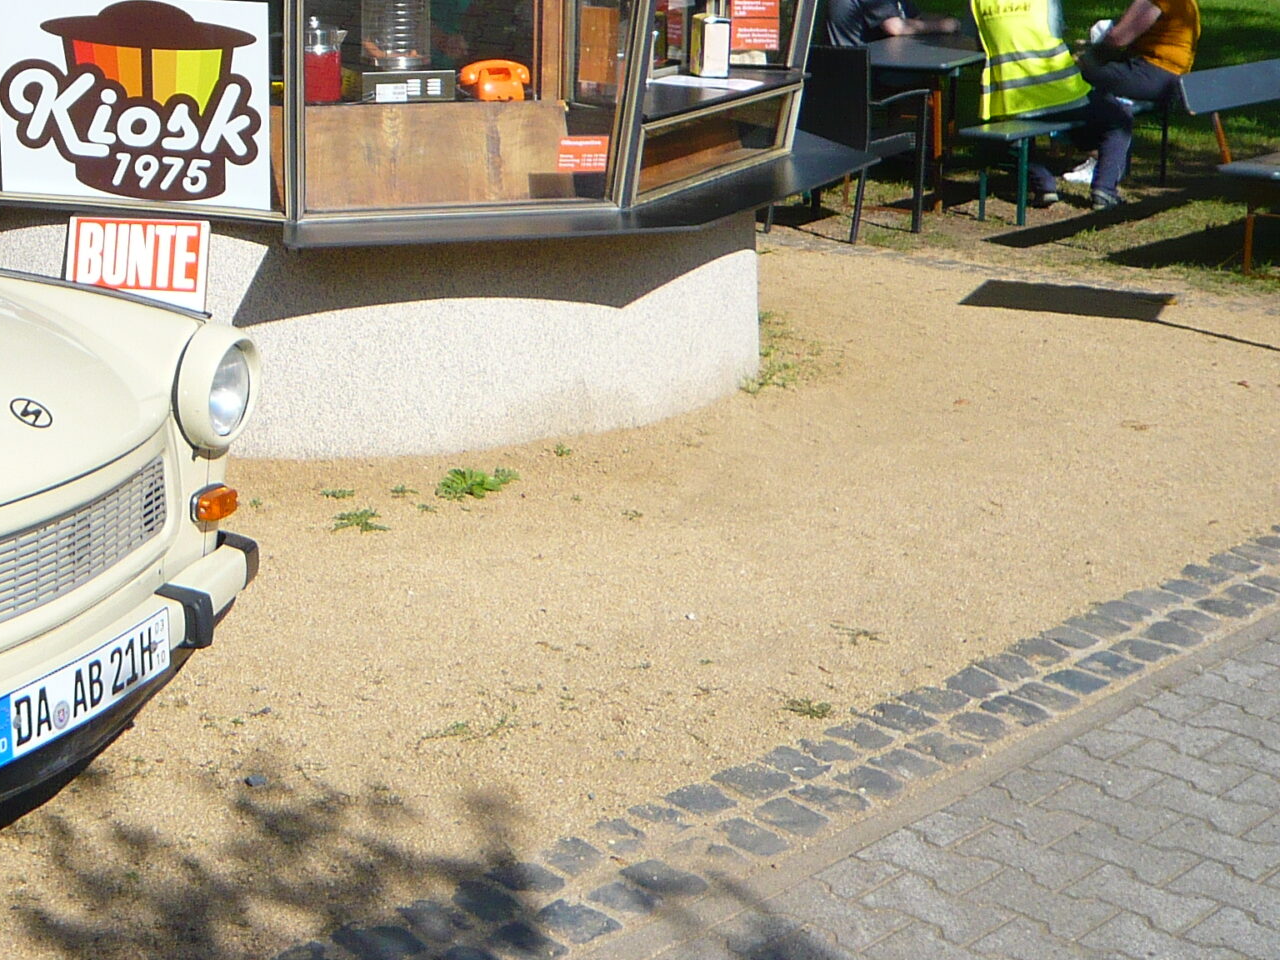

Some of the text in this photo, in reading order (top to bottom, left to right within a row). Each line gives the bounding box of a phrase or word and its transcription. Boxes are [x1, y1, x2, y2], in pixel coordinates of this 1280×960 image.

[8, 68, 251, 158] Kiosk
[111, 152, 211, 193] 1975
[76, 221, 198, 290] BUNTE
[154, 618, 165, 635] 03
[155, 649, 166, 666] 10
[13, 626, 154, 748] DA AB 21H
[0, 737, 8, 754] D
